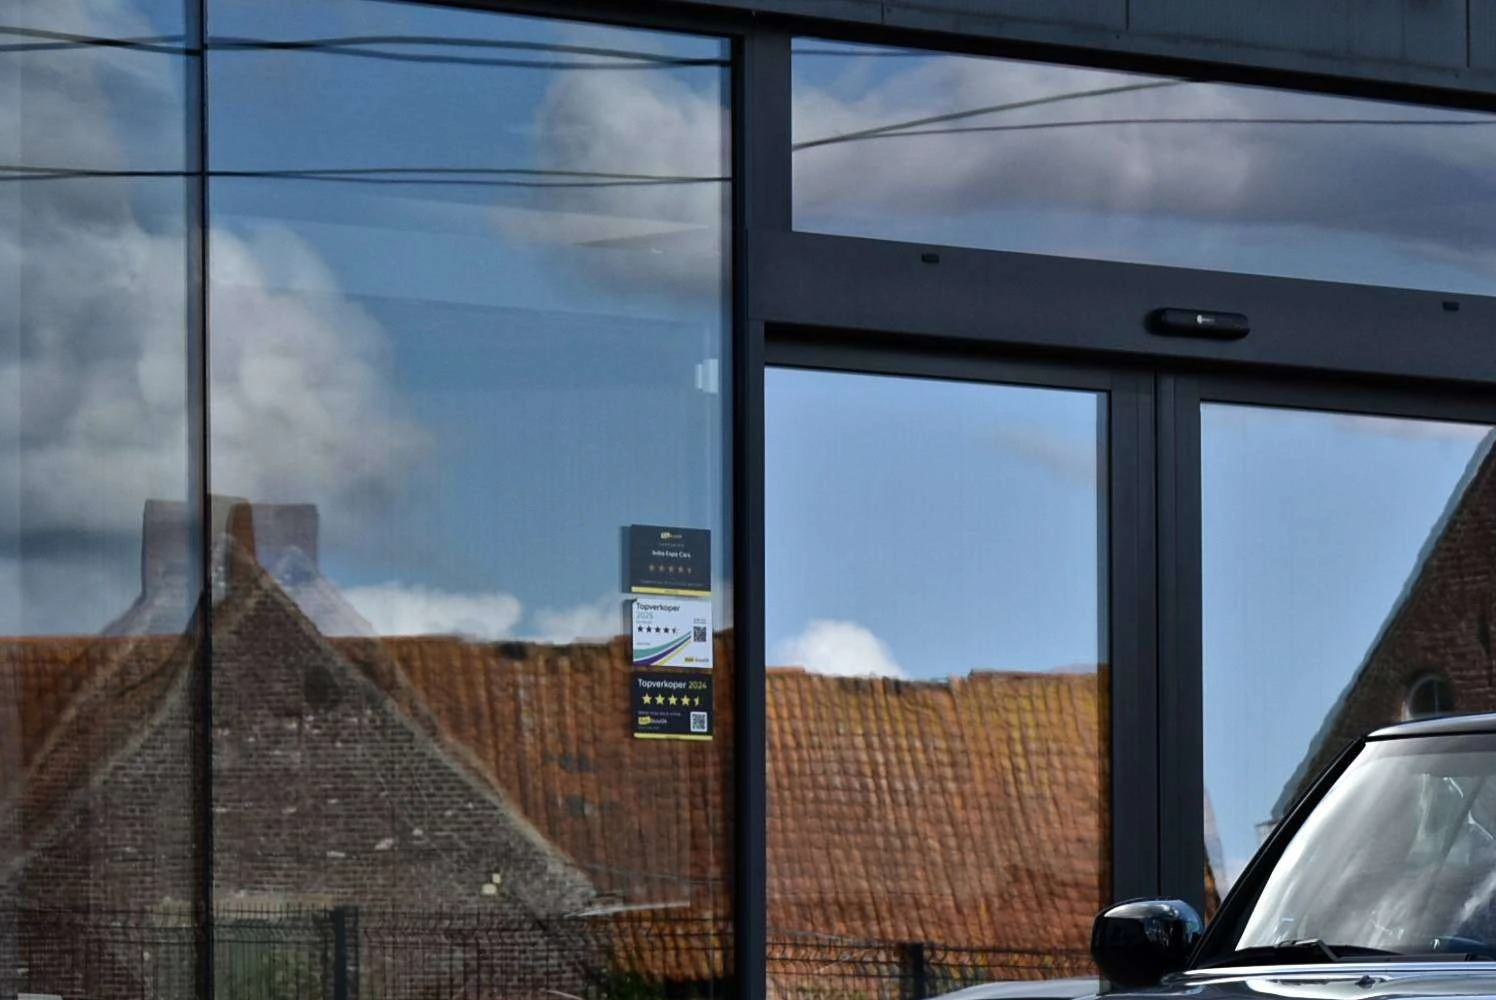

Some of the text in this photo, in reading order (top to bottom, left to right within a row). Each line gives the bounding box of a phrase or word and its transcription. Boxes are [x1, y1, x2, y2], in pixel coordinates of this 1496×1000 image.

[636, 603, 680, 612] Topverkoper
[638, 679, 707, 689] Topverkoper 2024
